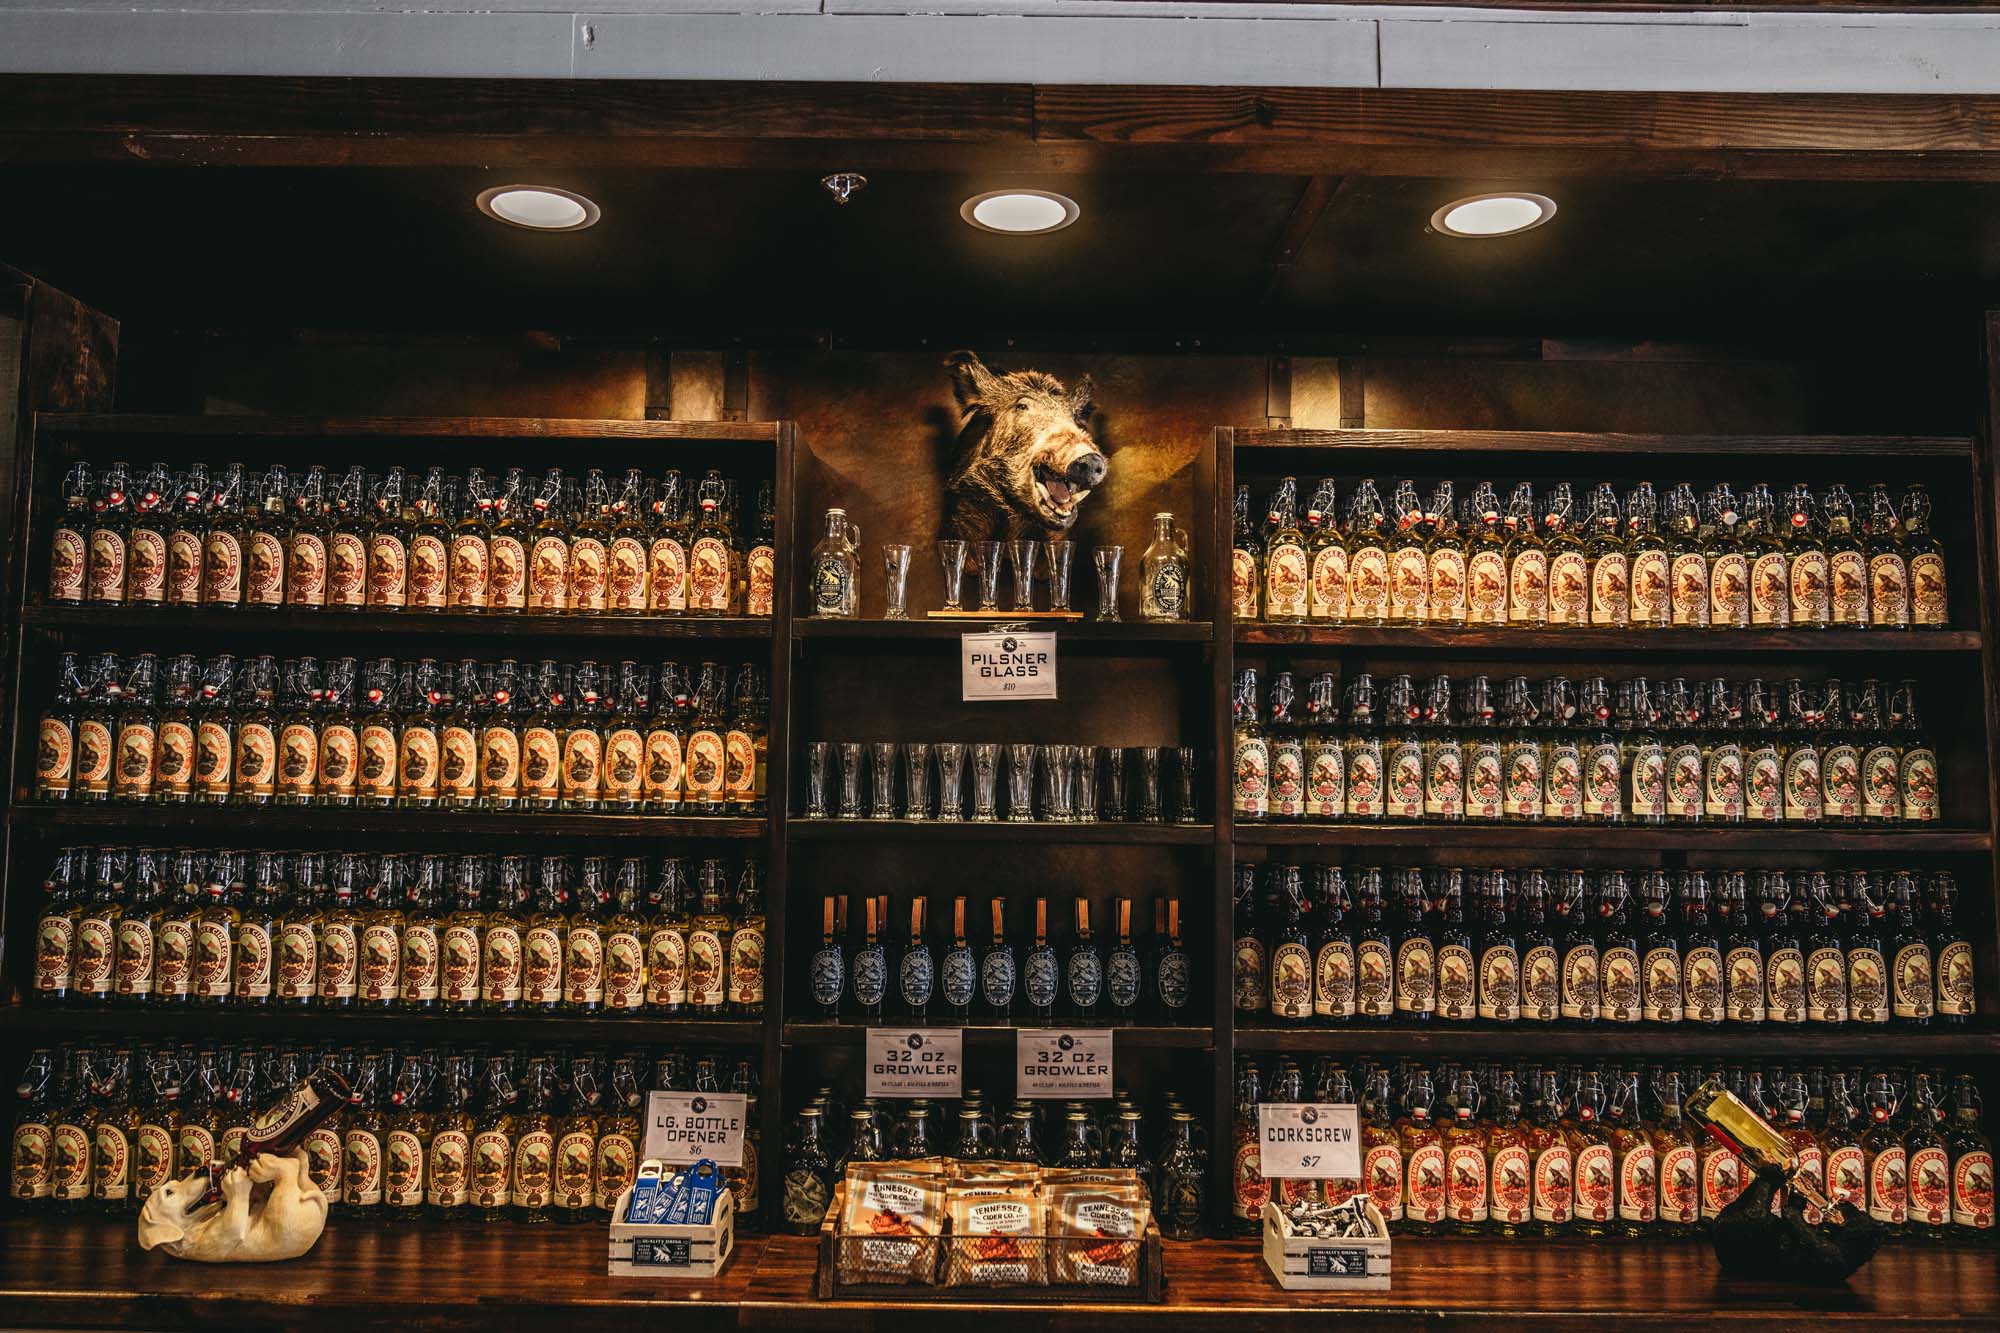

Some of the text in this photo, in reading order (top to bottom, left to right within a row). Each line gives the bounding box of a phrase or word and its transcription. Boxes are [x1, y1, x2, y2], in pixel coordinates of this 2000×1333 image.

[971, 653, 1048, 665] PILSNER
[980, 665, 1038, 677] GLASS
[96, 926, 110, 945] CIDER
[382, 932, 396, 952] CIDER
[1277, 988, 1290, 1004] HARD
[1321, 986, 1335, 1001] HARD
[1604, 992, 1619, 1007] HARD
[887, 1050, 912, 1062] 32
[1038, 1051, 1063, 1063] 32
[873, 1064, 957, 1075] GROWLER
[1024, 1065, 1109, 1076] GROWLER
[656, 1115, 739, 1131] LG. BOTTLE
[667, 1130, 727, 1144] OPENER
[1268, 1127, 1352, 1143] CORKSCREW
[689, 1144, 703, 1156] $6
[1301, 1155, 1321, 1168] $7
[879, 1193, 898, 1201] CIDER
[975, 1204, 1024, 1215] TENNESSEE
[983, 1213, 1002, 1221] CIDER
[1090, 1212, 1111, 1221] CIDER
